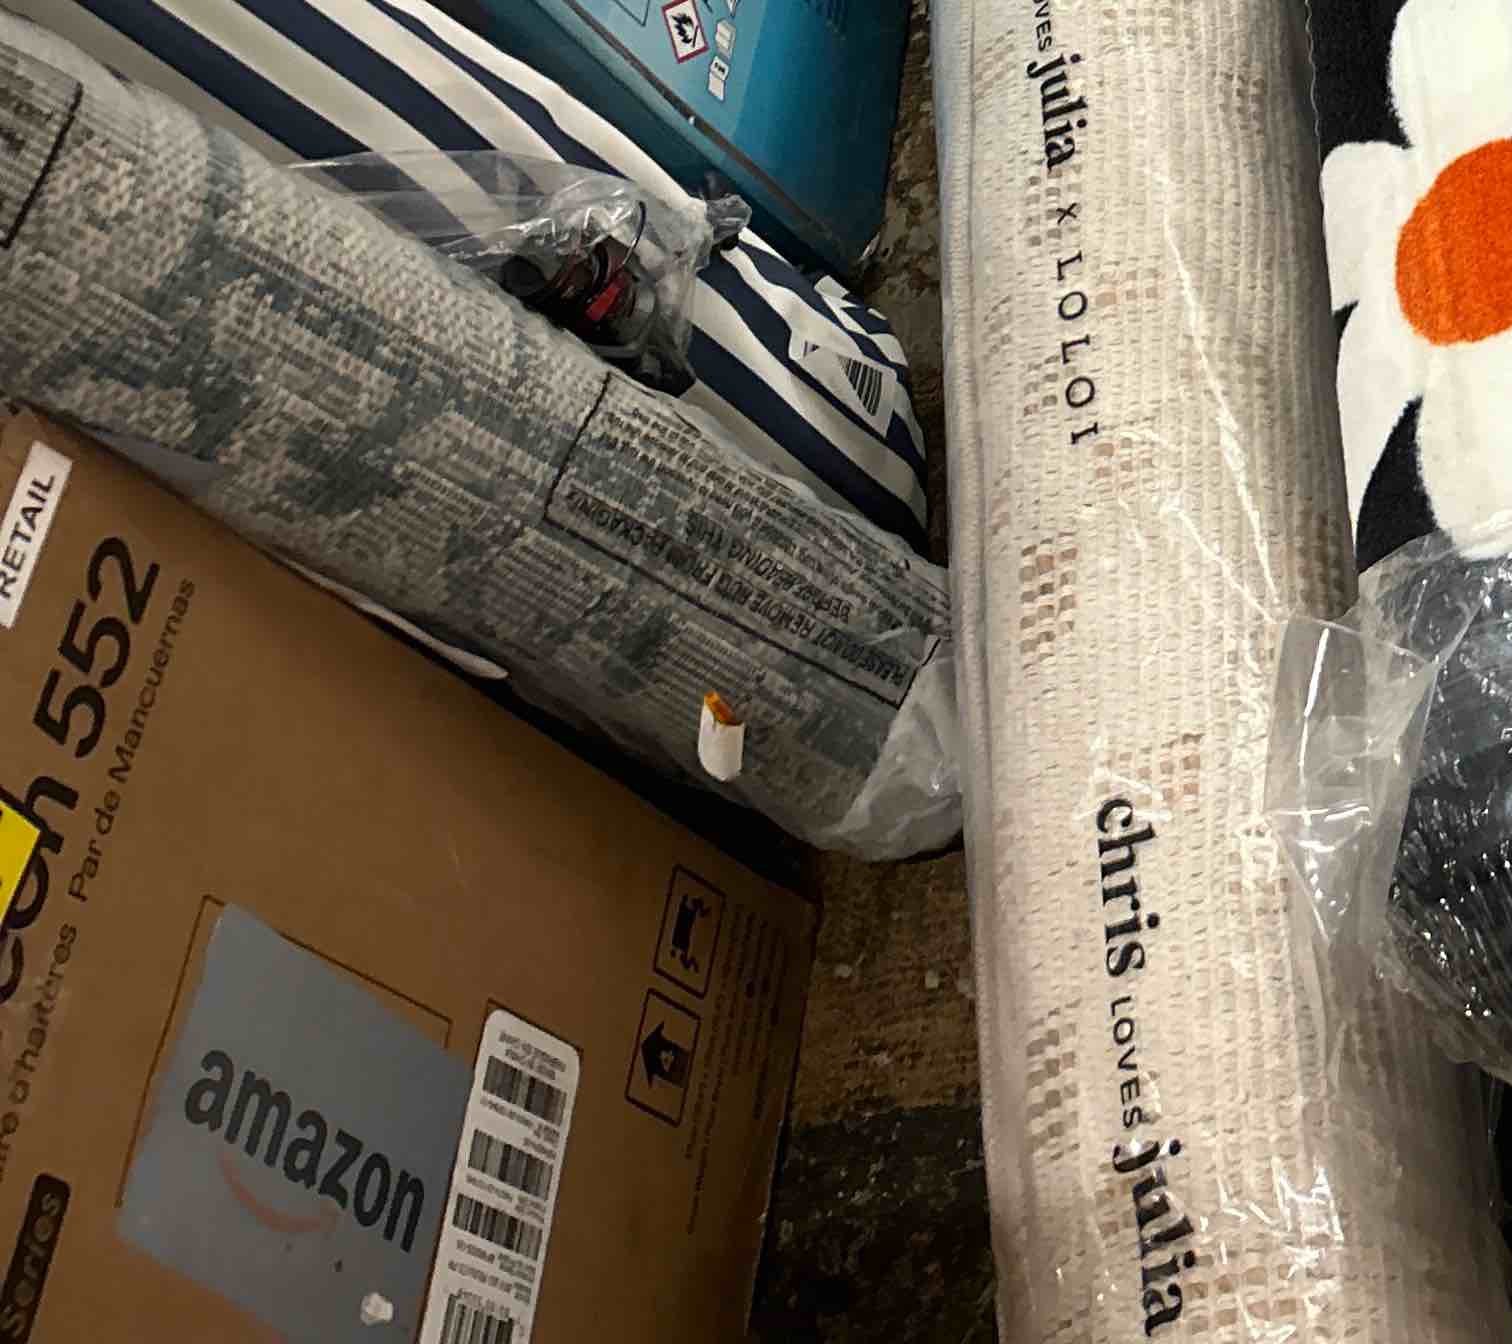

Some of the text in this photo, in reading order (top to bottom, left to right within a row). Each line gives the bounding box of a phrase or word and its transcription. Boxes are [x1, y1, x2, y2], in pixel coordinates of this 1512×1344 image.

[1026, 52, 1089, 171] julia
[1056, 250, 1100, 446] LOLOI
[0, 474, 56, 600] RETAIL
[33, 536, 160, 759] 552
[68, 841, 103, 902] Par
[88, 794, 121, 837] de
[107, 577, 197, 783] Mancuernas
[183, 1045, 426, 1253] amazon
[1096, 797, 1197, 1337] chris LOVES julia
